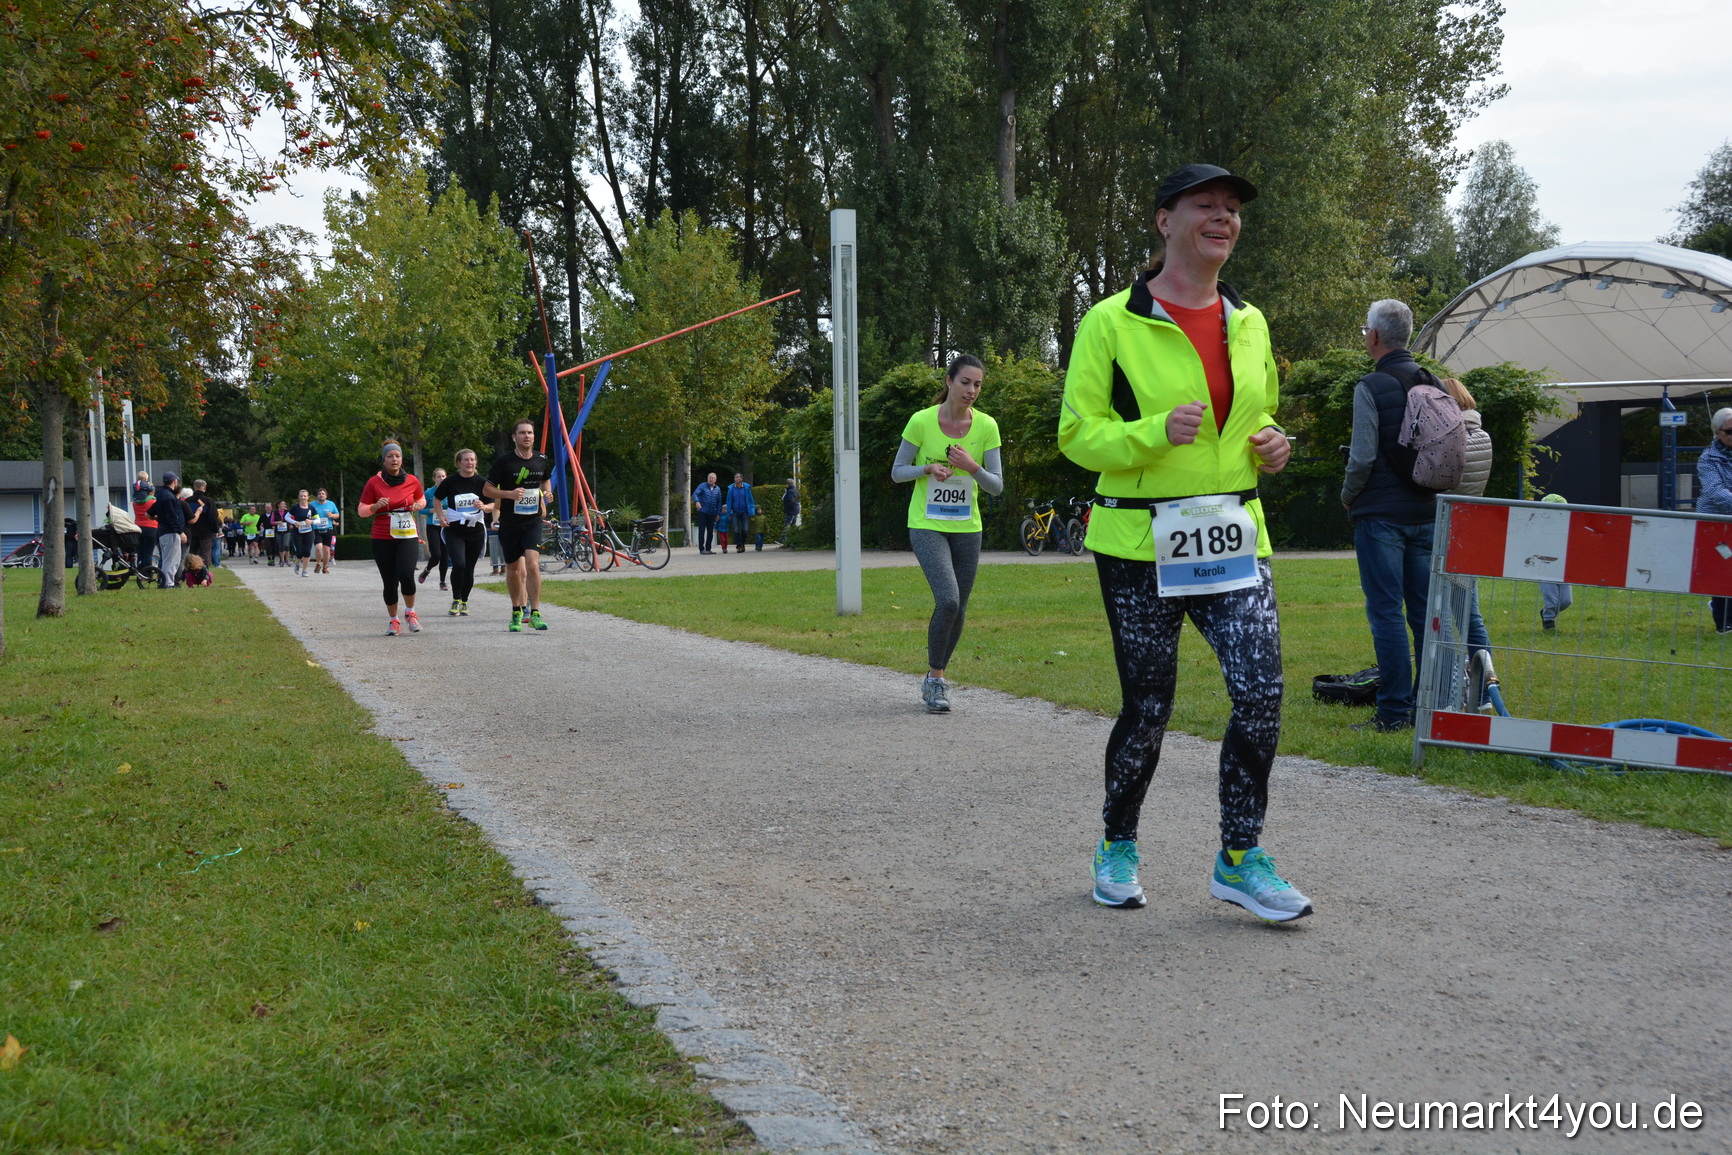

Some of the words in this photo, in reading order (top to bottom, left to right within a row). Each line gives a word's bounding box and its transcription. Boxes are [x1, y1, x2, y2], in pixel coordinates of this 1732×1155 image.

[519, 497, 537, 505] 2369
[934, 489, 966, 503] 2094
[398, 520, 411, 528] 123
[1170, 523, 1242, 558] 2189
[1194, 565, 1226, 578] Karola
